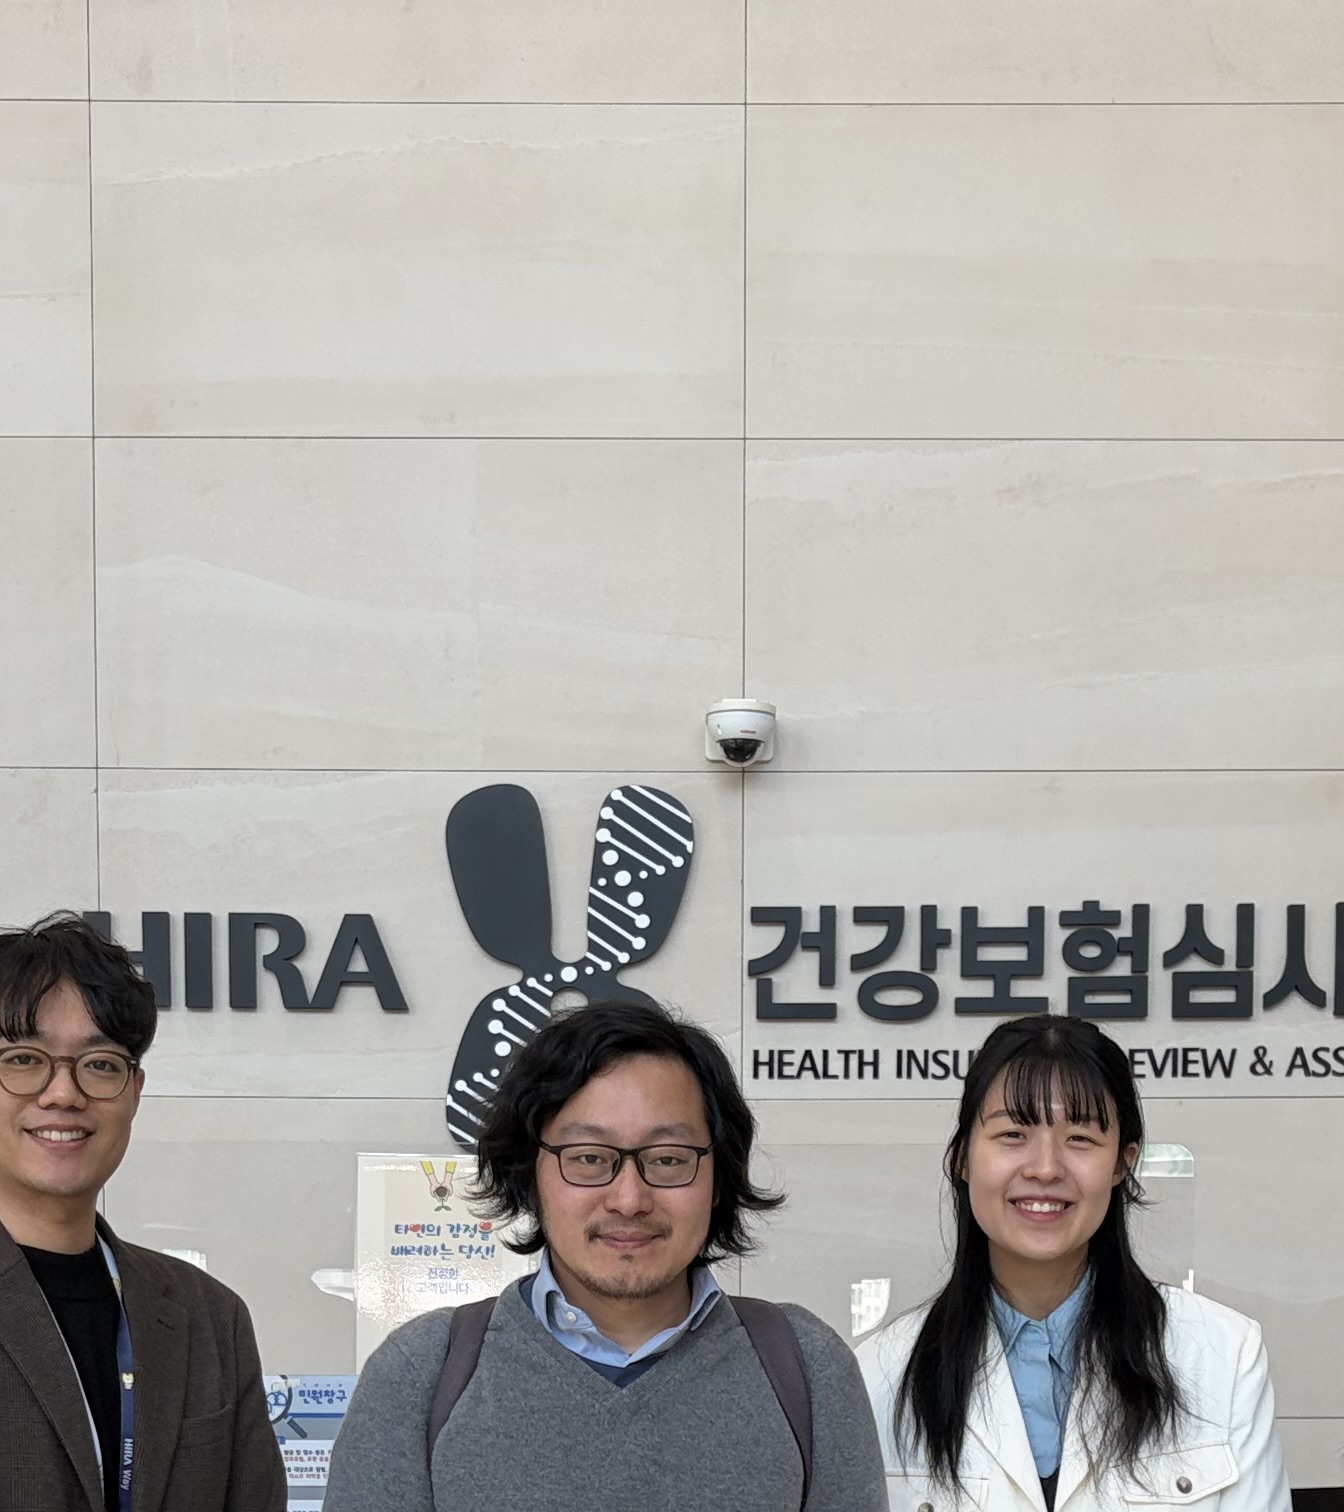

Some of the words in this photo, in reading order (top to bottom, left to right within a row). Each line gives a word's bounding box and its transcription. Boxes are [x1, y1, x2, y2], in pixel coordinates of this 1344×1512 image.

[83, 911, 410, 1011] HIRA
[752, 1048, 880, 1080] HEALTH
[1130, 1047, 1237, 1079] EVIEW
[1249, 1046, 1274, 1077] &
[390, 1242, 455, 1261] 배려하는
[458, 1244, 496, 1260] 당신!
